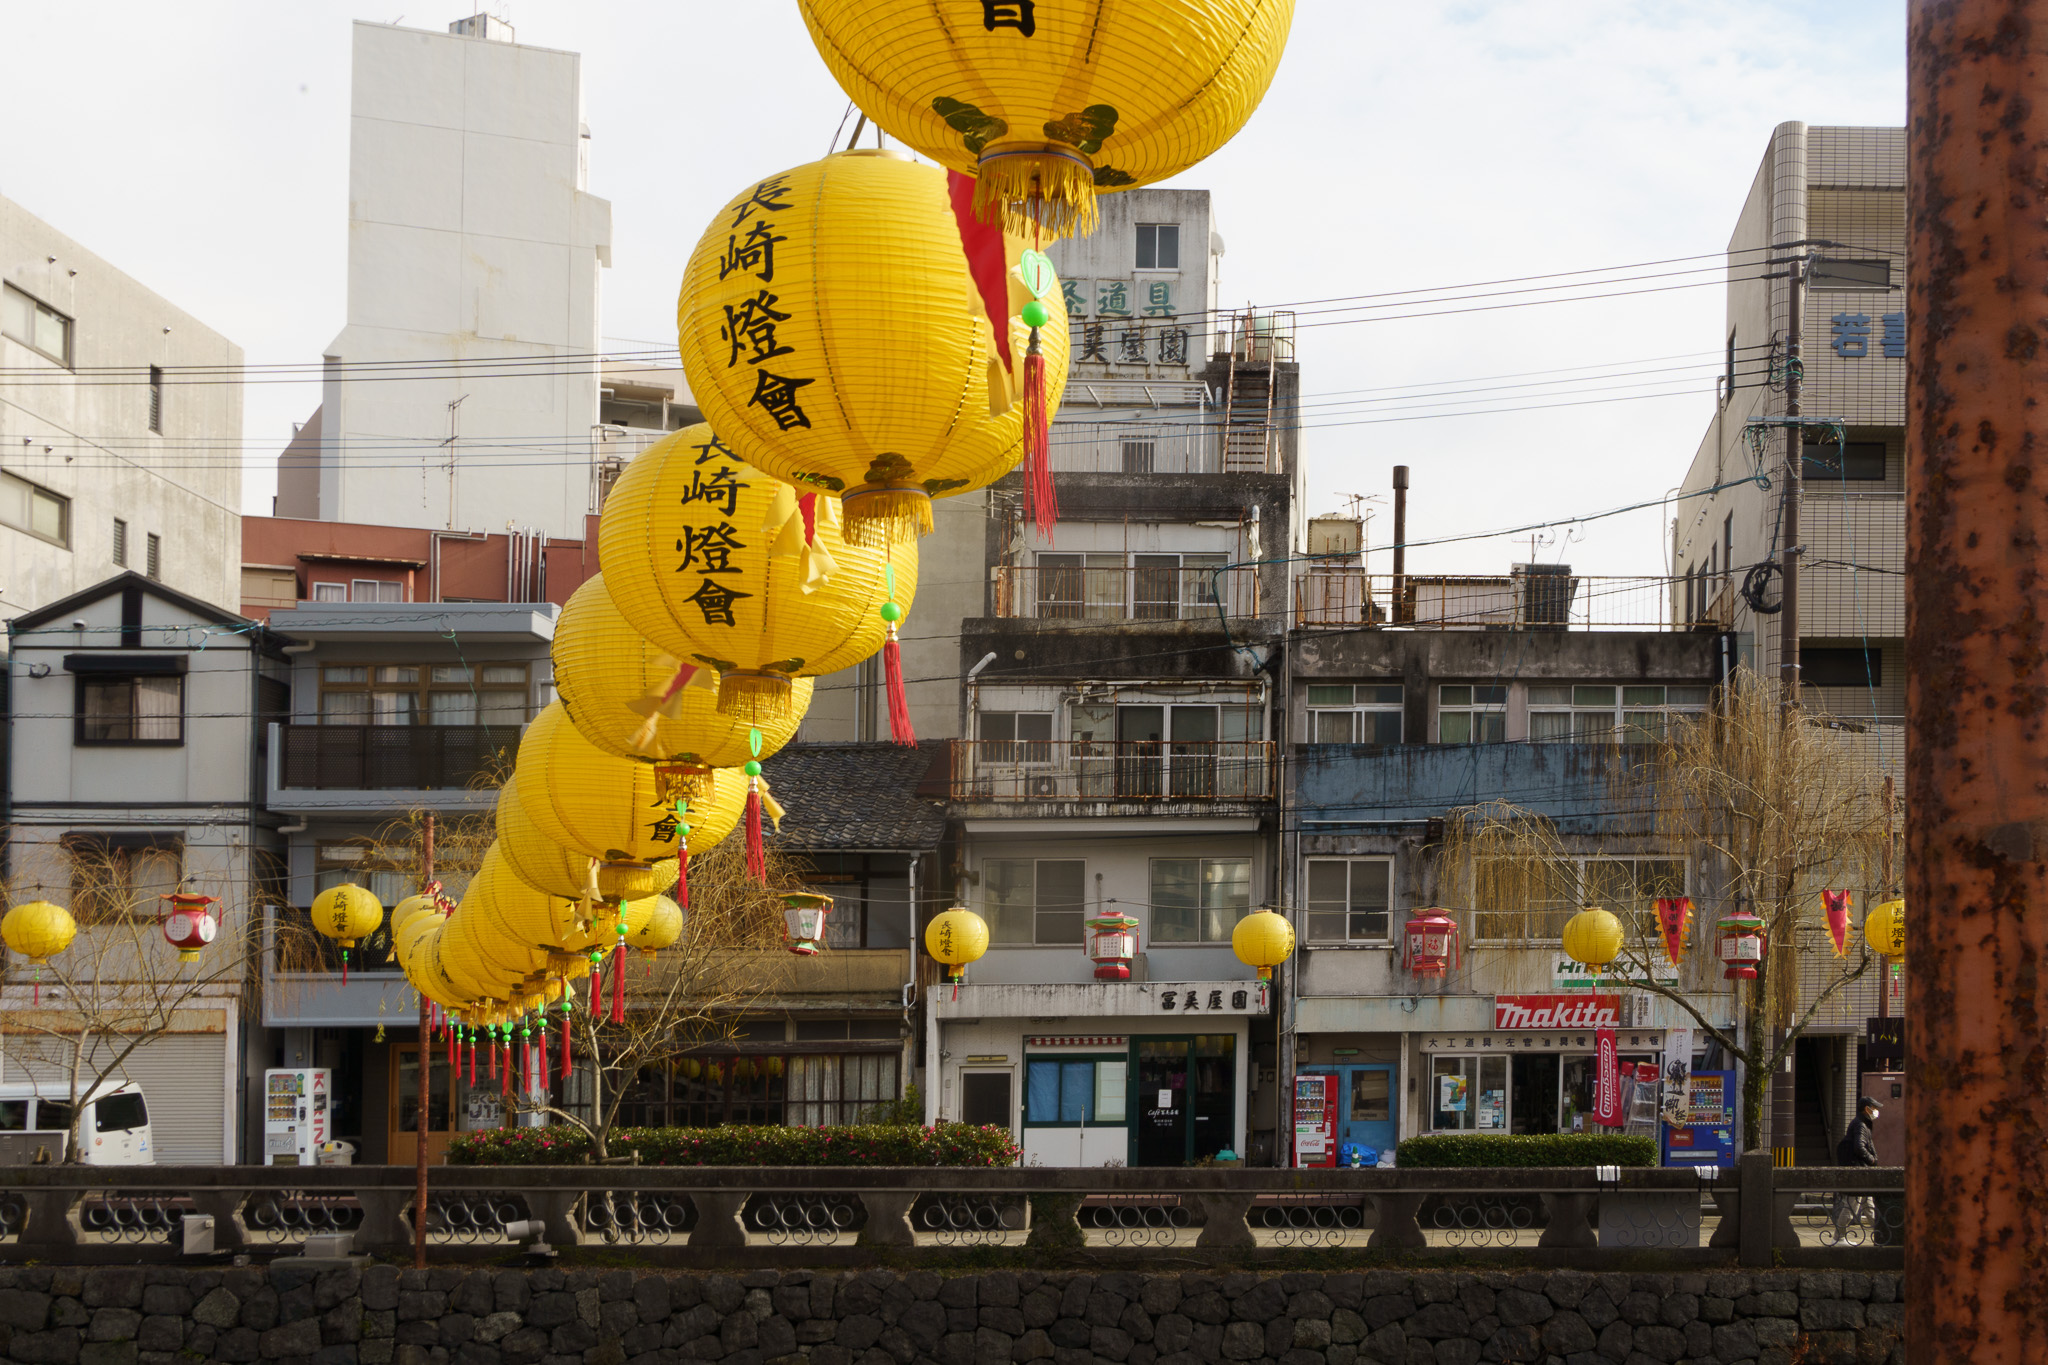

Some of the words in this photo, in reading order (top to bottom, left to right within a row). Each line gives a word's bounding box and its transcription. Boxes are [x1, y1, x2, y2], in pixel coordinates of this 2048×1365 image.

[719, 174, 816, 432] 長崎燈會
[1603, 1044, 1611, 1113] Hasegawa
